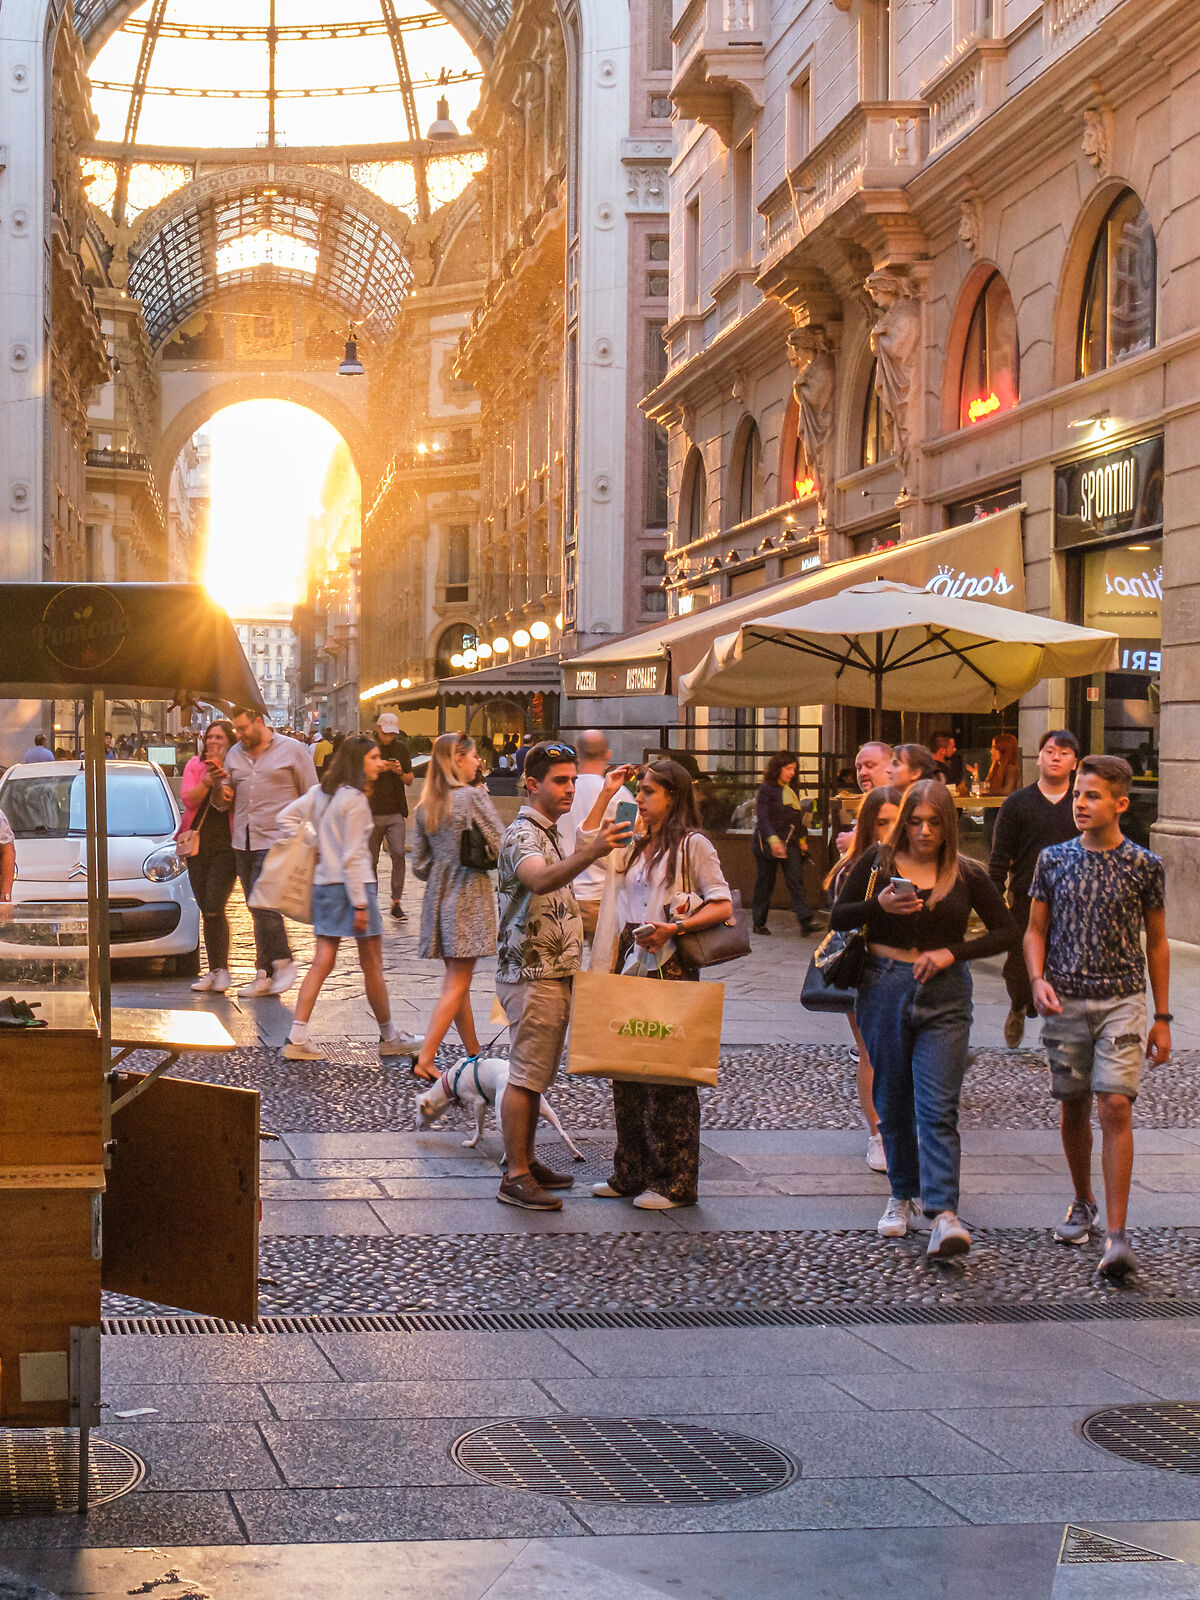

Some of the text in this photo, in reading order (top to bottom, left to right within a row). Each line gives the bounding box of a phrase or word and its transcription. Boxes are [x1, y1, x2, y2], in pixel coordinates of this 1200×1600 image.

[1080, 458, 1135, 522] SPONTINI
[576, 671, 597, 690] PIZZERIA
[626, 667, 657, 690] RISTORANTE
[608, 1018, 686, 1040] CARPISA
